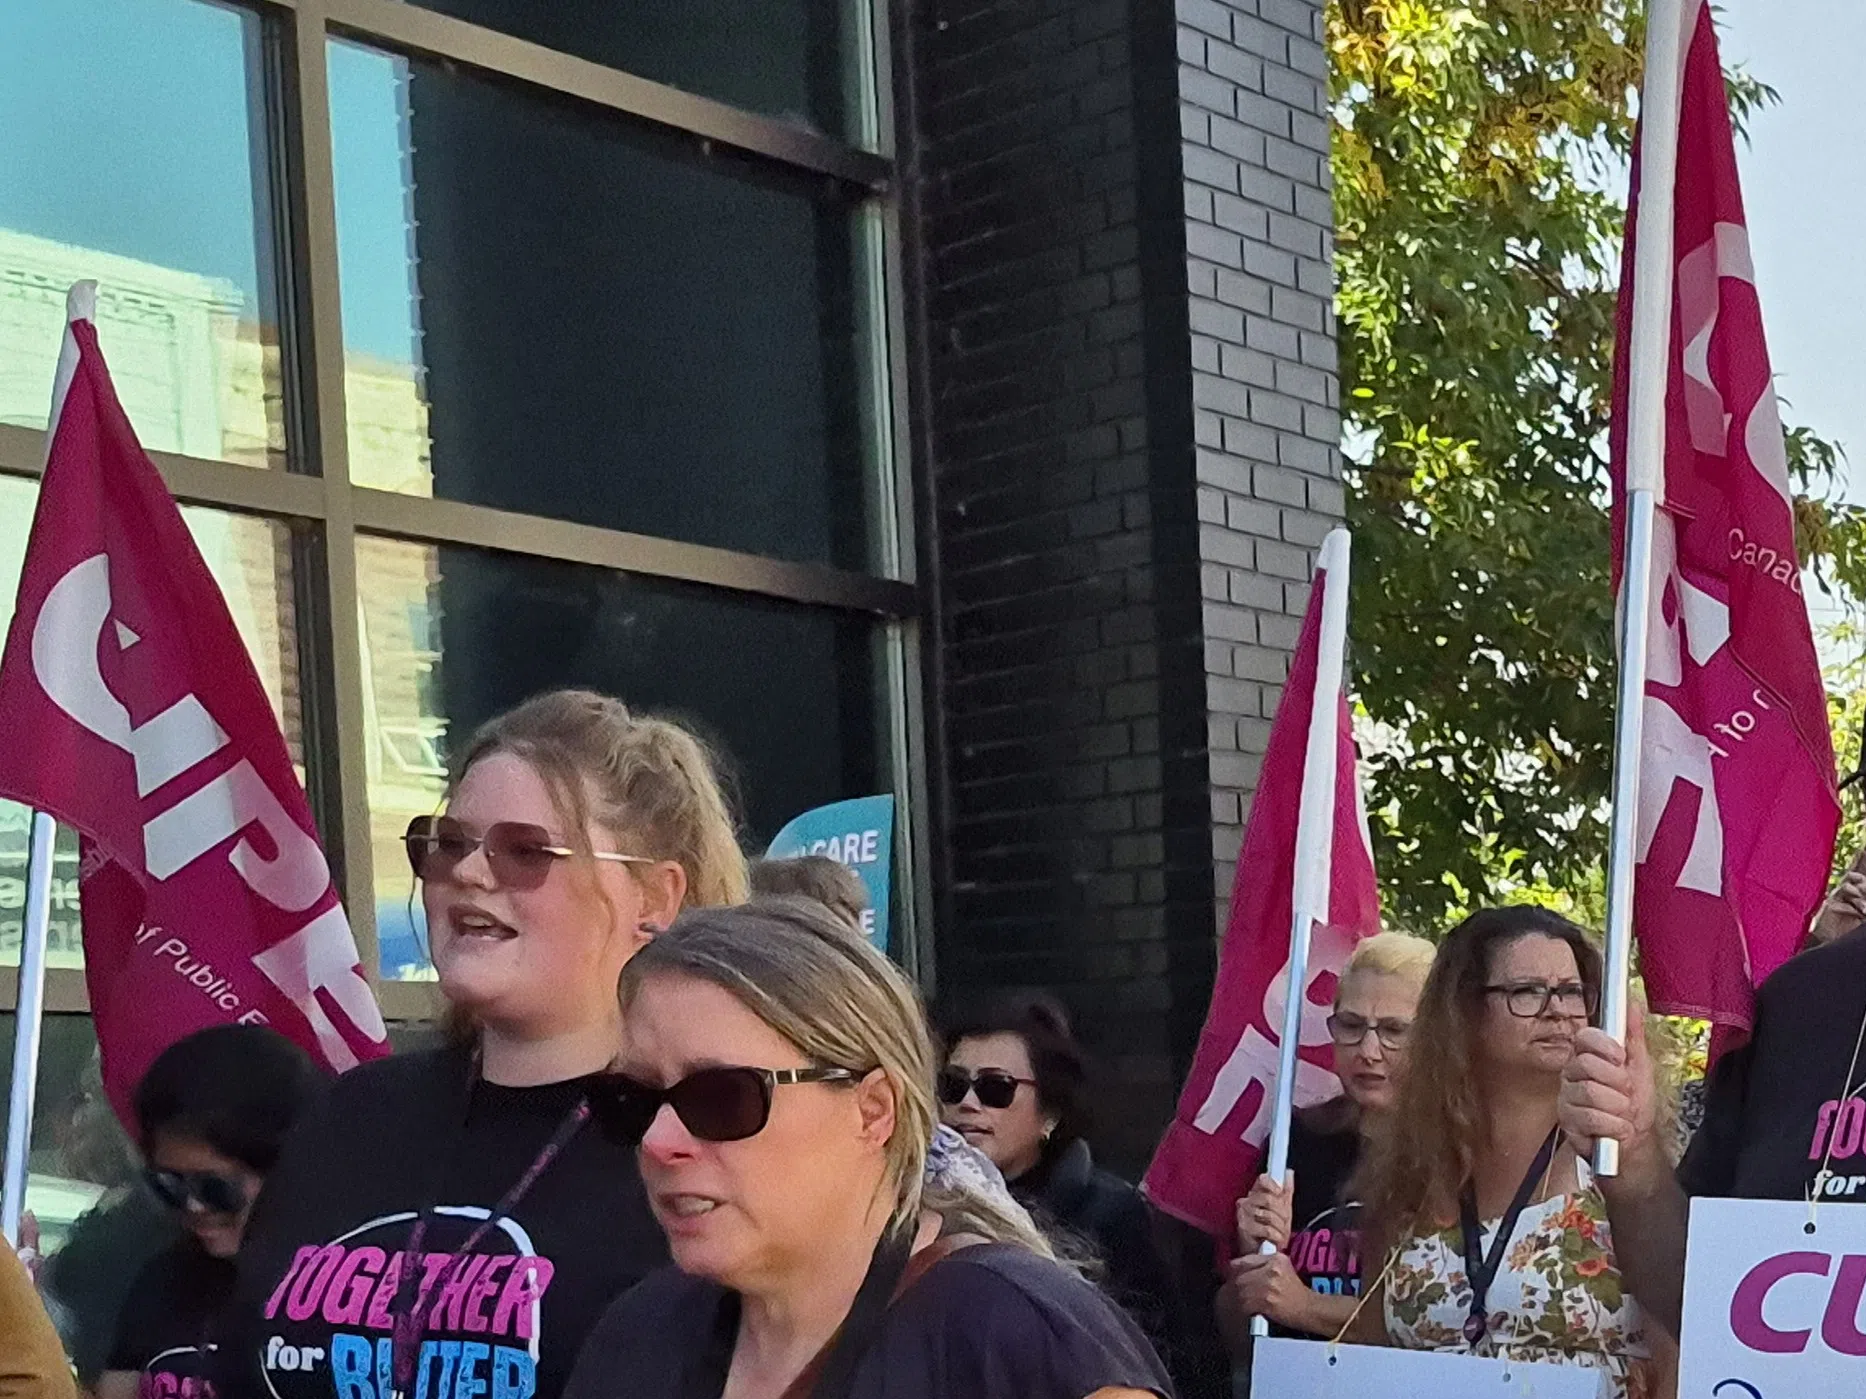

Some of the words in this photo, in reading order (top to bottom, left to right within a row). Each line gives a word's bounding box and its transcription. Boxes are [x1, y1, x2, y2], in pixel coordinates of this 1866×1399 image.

[153, 938, 240, 1010] Public
[1812, 1170, 1866, 1197] for
[266, 1336, 325, 1371] for
